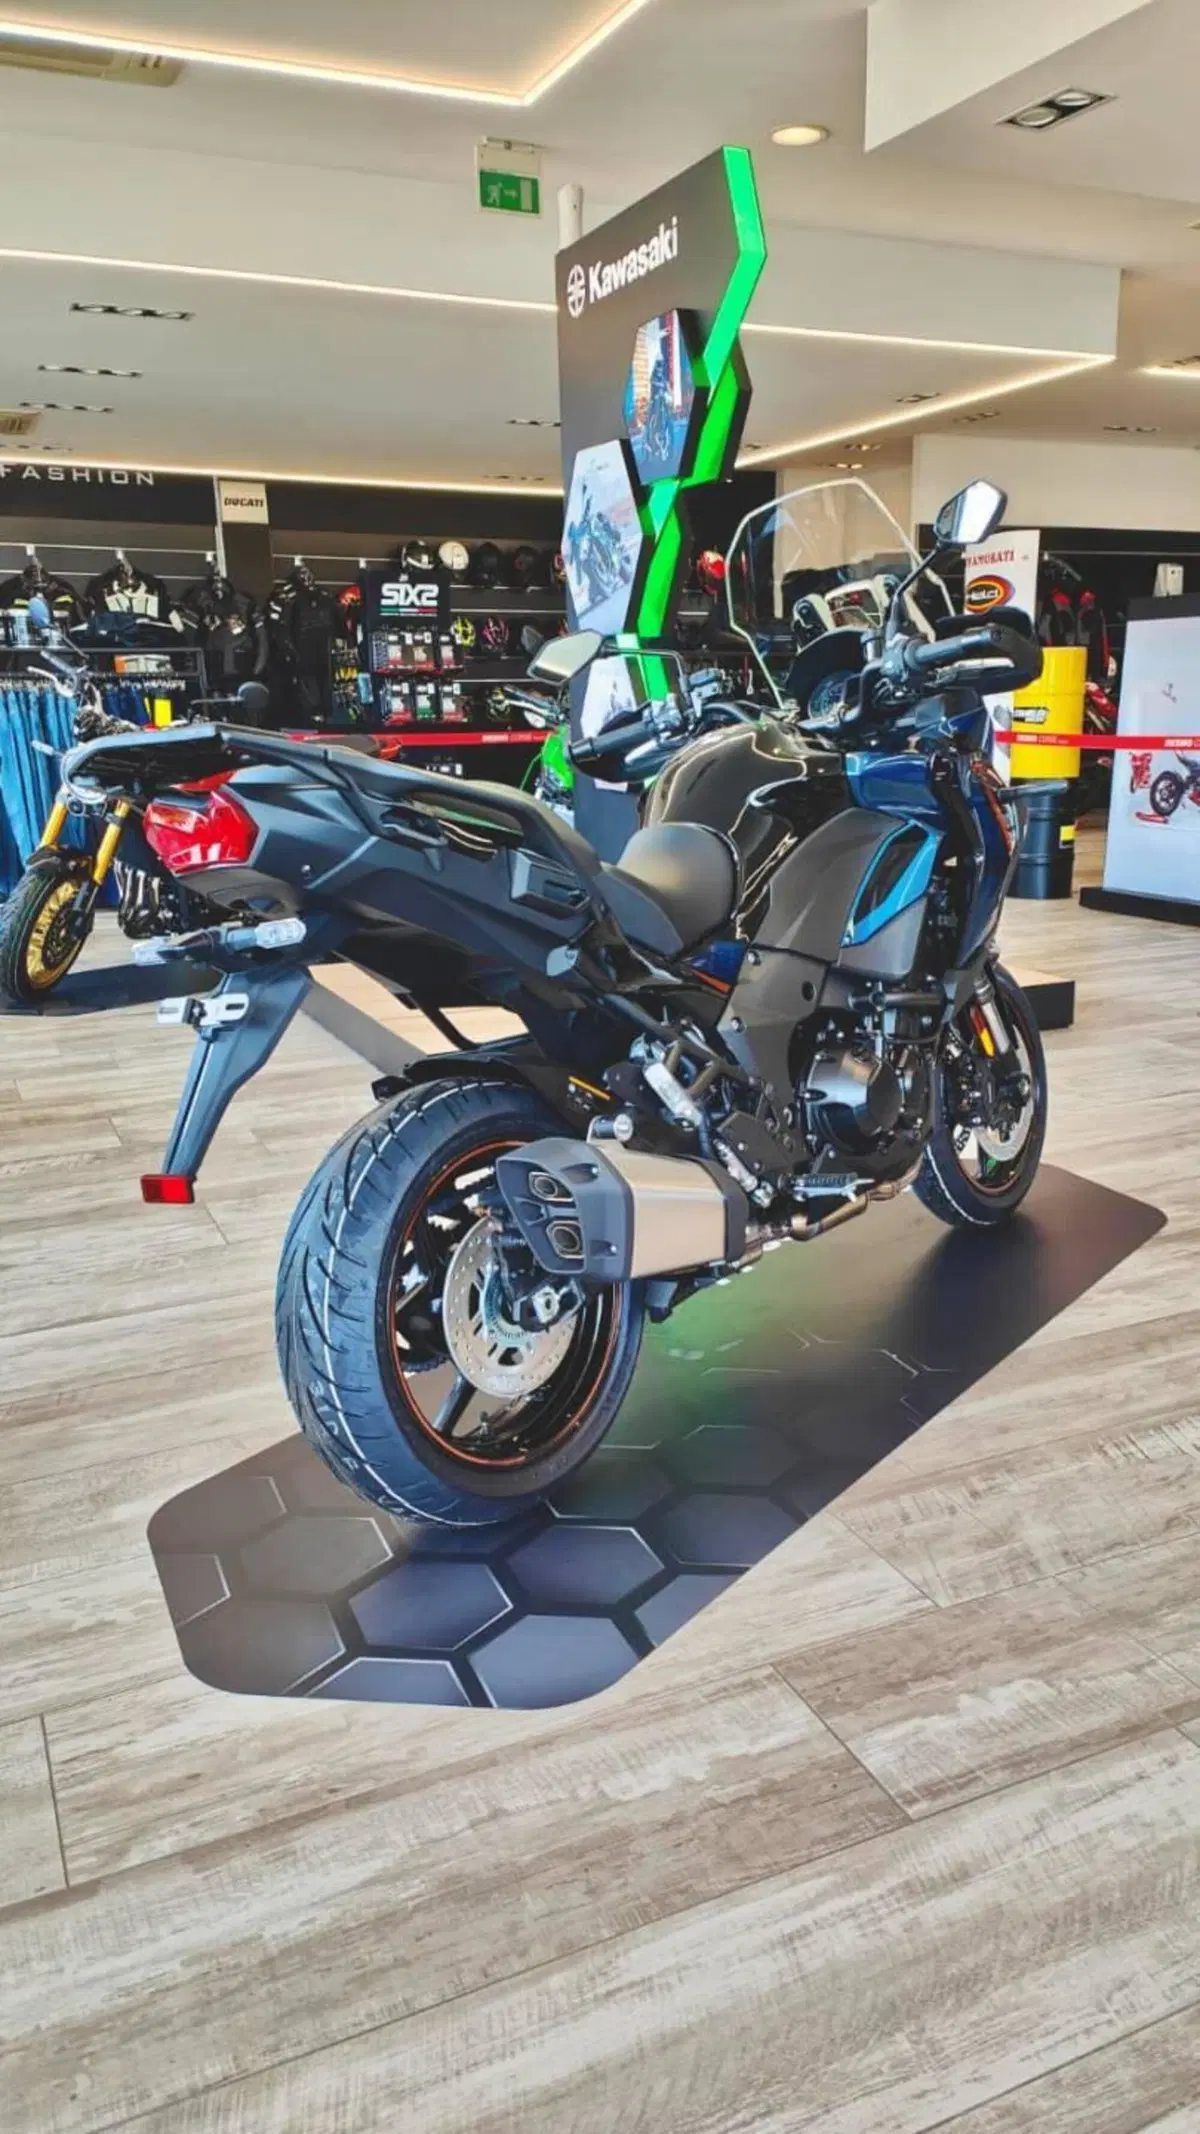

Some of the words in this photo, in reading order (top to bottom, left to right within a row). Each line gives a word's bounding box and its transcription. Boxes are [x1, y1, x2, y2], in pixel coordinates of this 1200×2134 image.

[588, 215, 679, 304] Kawasaki
[0, 463, 155, 486] FASHION
[223, 497, 264, 508] DUCATI
[381, 582, 439, 606] SIX2
